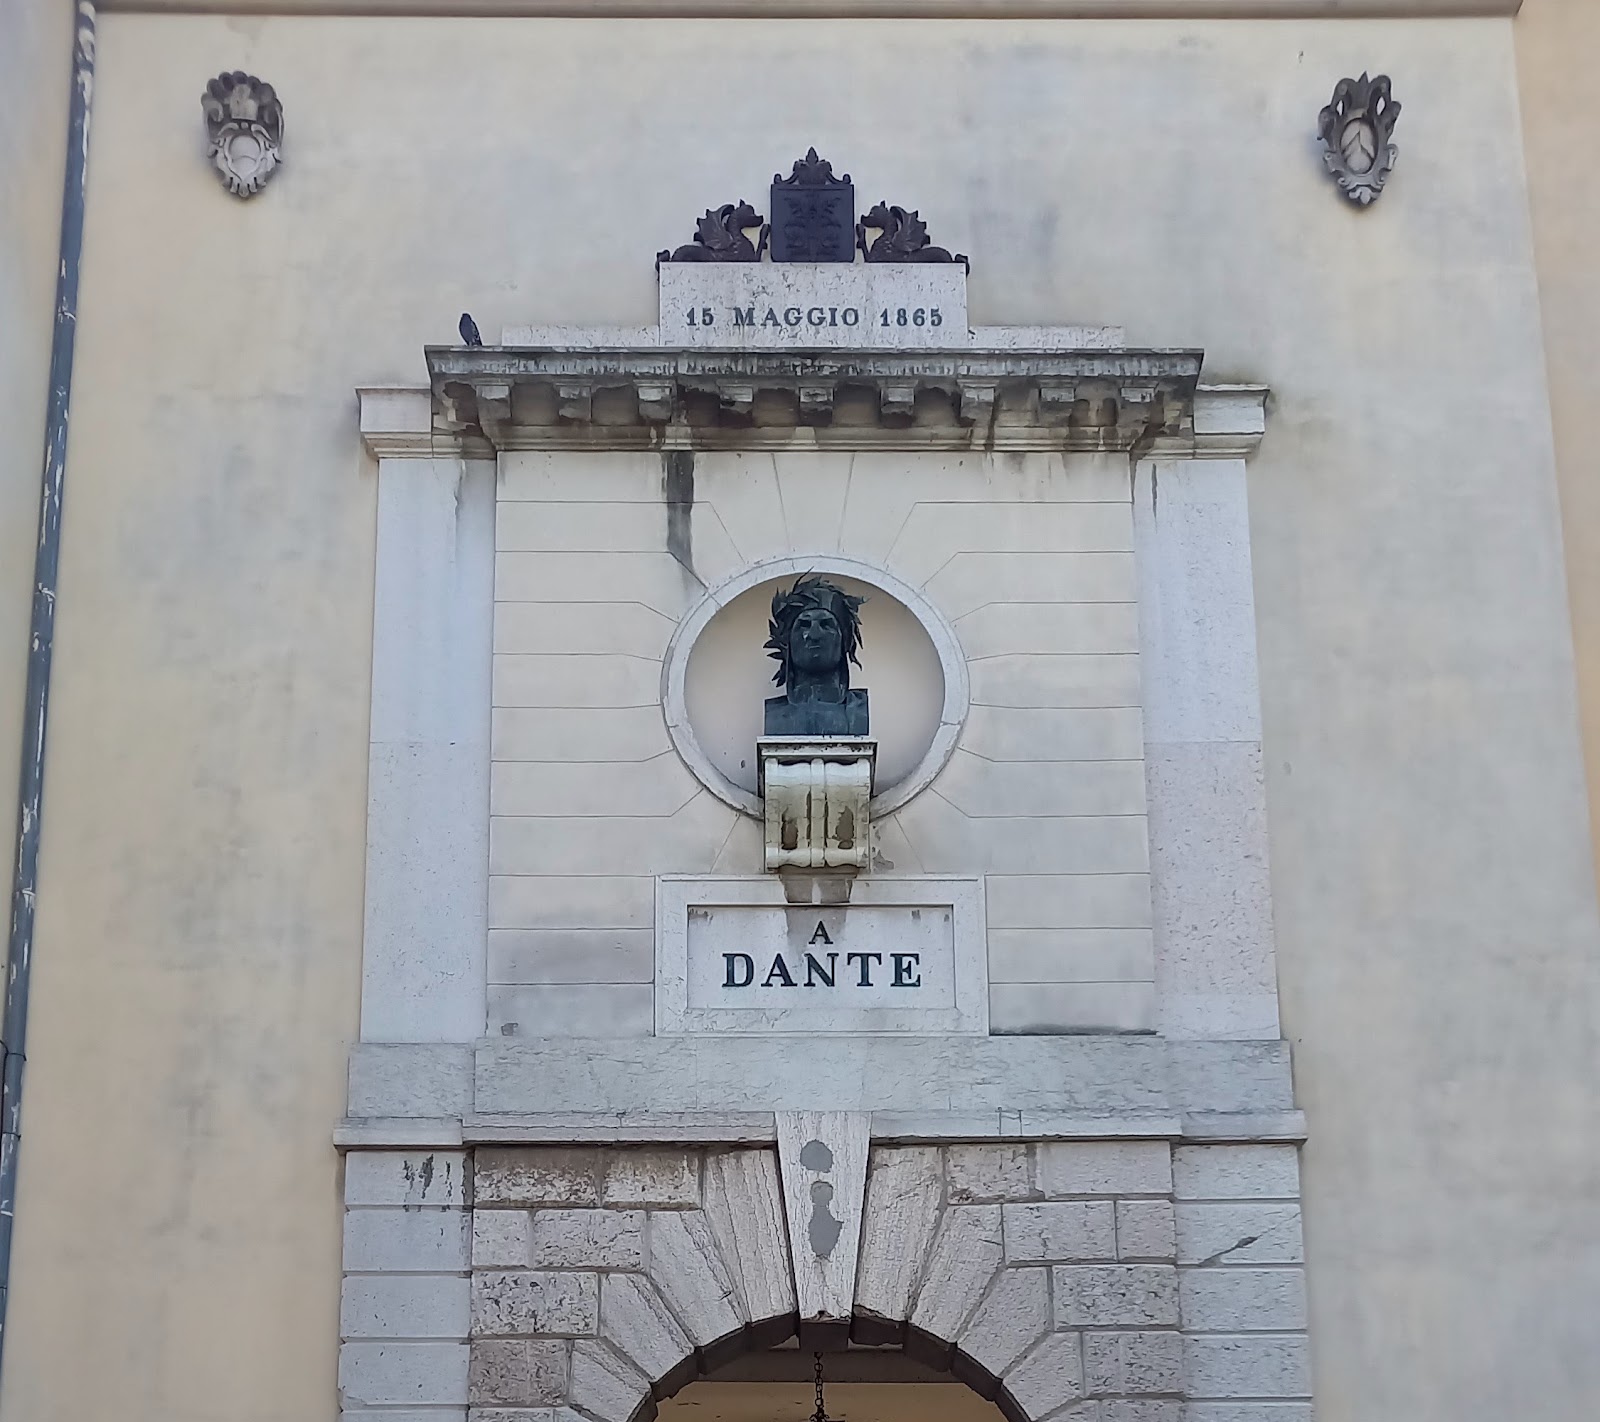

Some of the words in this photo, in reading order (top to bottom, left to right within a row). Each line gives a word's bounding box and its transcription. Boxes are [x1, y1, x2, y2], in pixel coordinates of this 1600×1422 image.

[686, 307, 714, 326] 15
[733, 307, 860, 327] MAGGIO
[879, 308, 943, 327] 1865
[808, 920, 834, 945] A
[721, 952, 922, 988] DANTE
